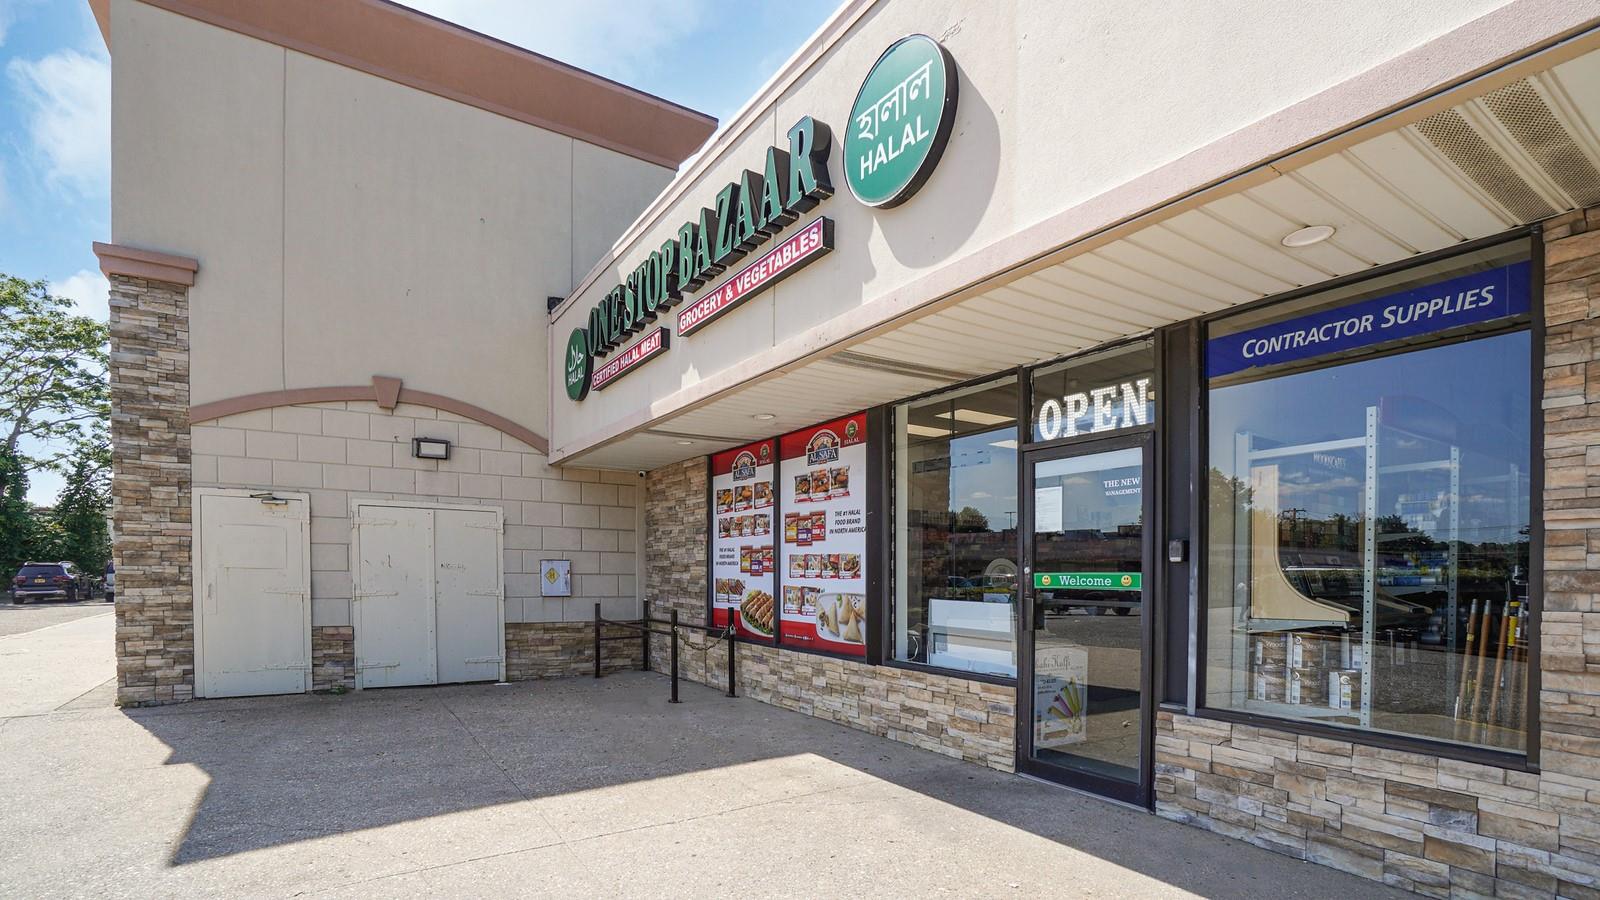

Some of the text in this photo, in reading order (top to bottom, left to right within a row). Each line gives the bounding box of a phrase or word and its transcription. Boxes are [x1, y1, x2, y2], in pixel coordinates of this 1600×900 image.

[860, 115, 930, 180] HALAL
[587, 115, 826, 357] ONE STOP BAZAAR
[680, 227, 819, 330] GROCERY & VEGETABLES
[1242, 285, 1495, 358] CONTRACTOR SUPPLIES
[568, 367, 584, 387] HALAL
[593, 333, 660, 386] CERTIFIED HALAL MEAT
[1039, 379, 1149, 440] OPEN
[1104, 477, 1140, 488] THE NEW
[1105, 488, 1142, 496] MANAGEMENT
[1059, 575, 1112, 586] Welcome
